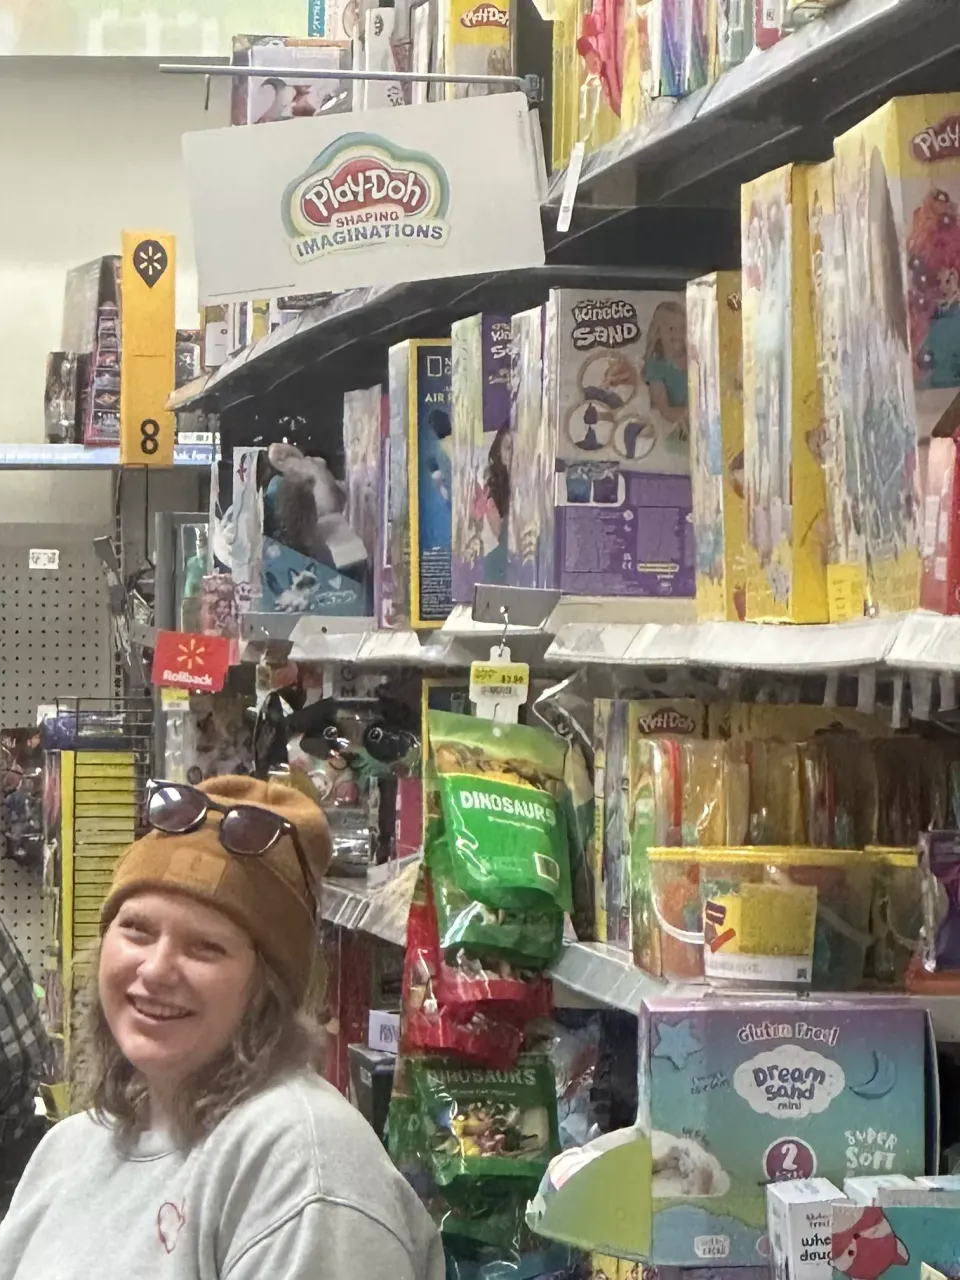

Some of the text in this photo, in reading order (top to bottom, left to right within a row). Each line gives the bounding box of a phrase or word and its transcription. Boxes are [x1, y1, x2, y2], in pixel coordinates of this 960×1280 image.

[304, 168, 422, 217] Play-Doh
[336, 211, 400, 228] SHAPING
[296, 223, 444, 257] IMAGINATIONS
[140, 419, 160, 455] 8
[162, 669, 213, 686] Rollback
[460, 790, 557, 827] DINOSAURS
[752, 1064, 827, 1088] Dream
[777, 1101, 802, 1110] mini
[780, 1143, 798, 1171] 2
